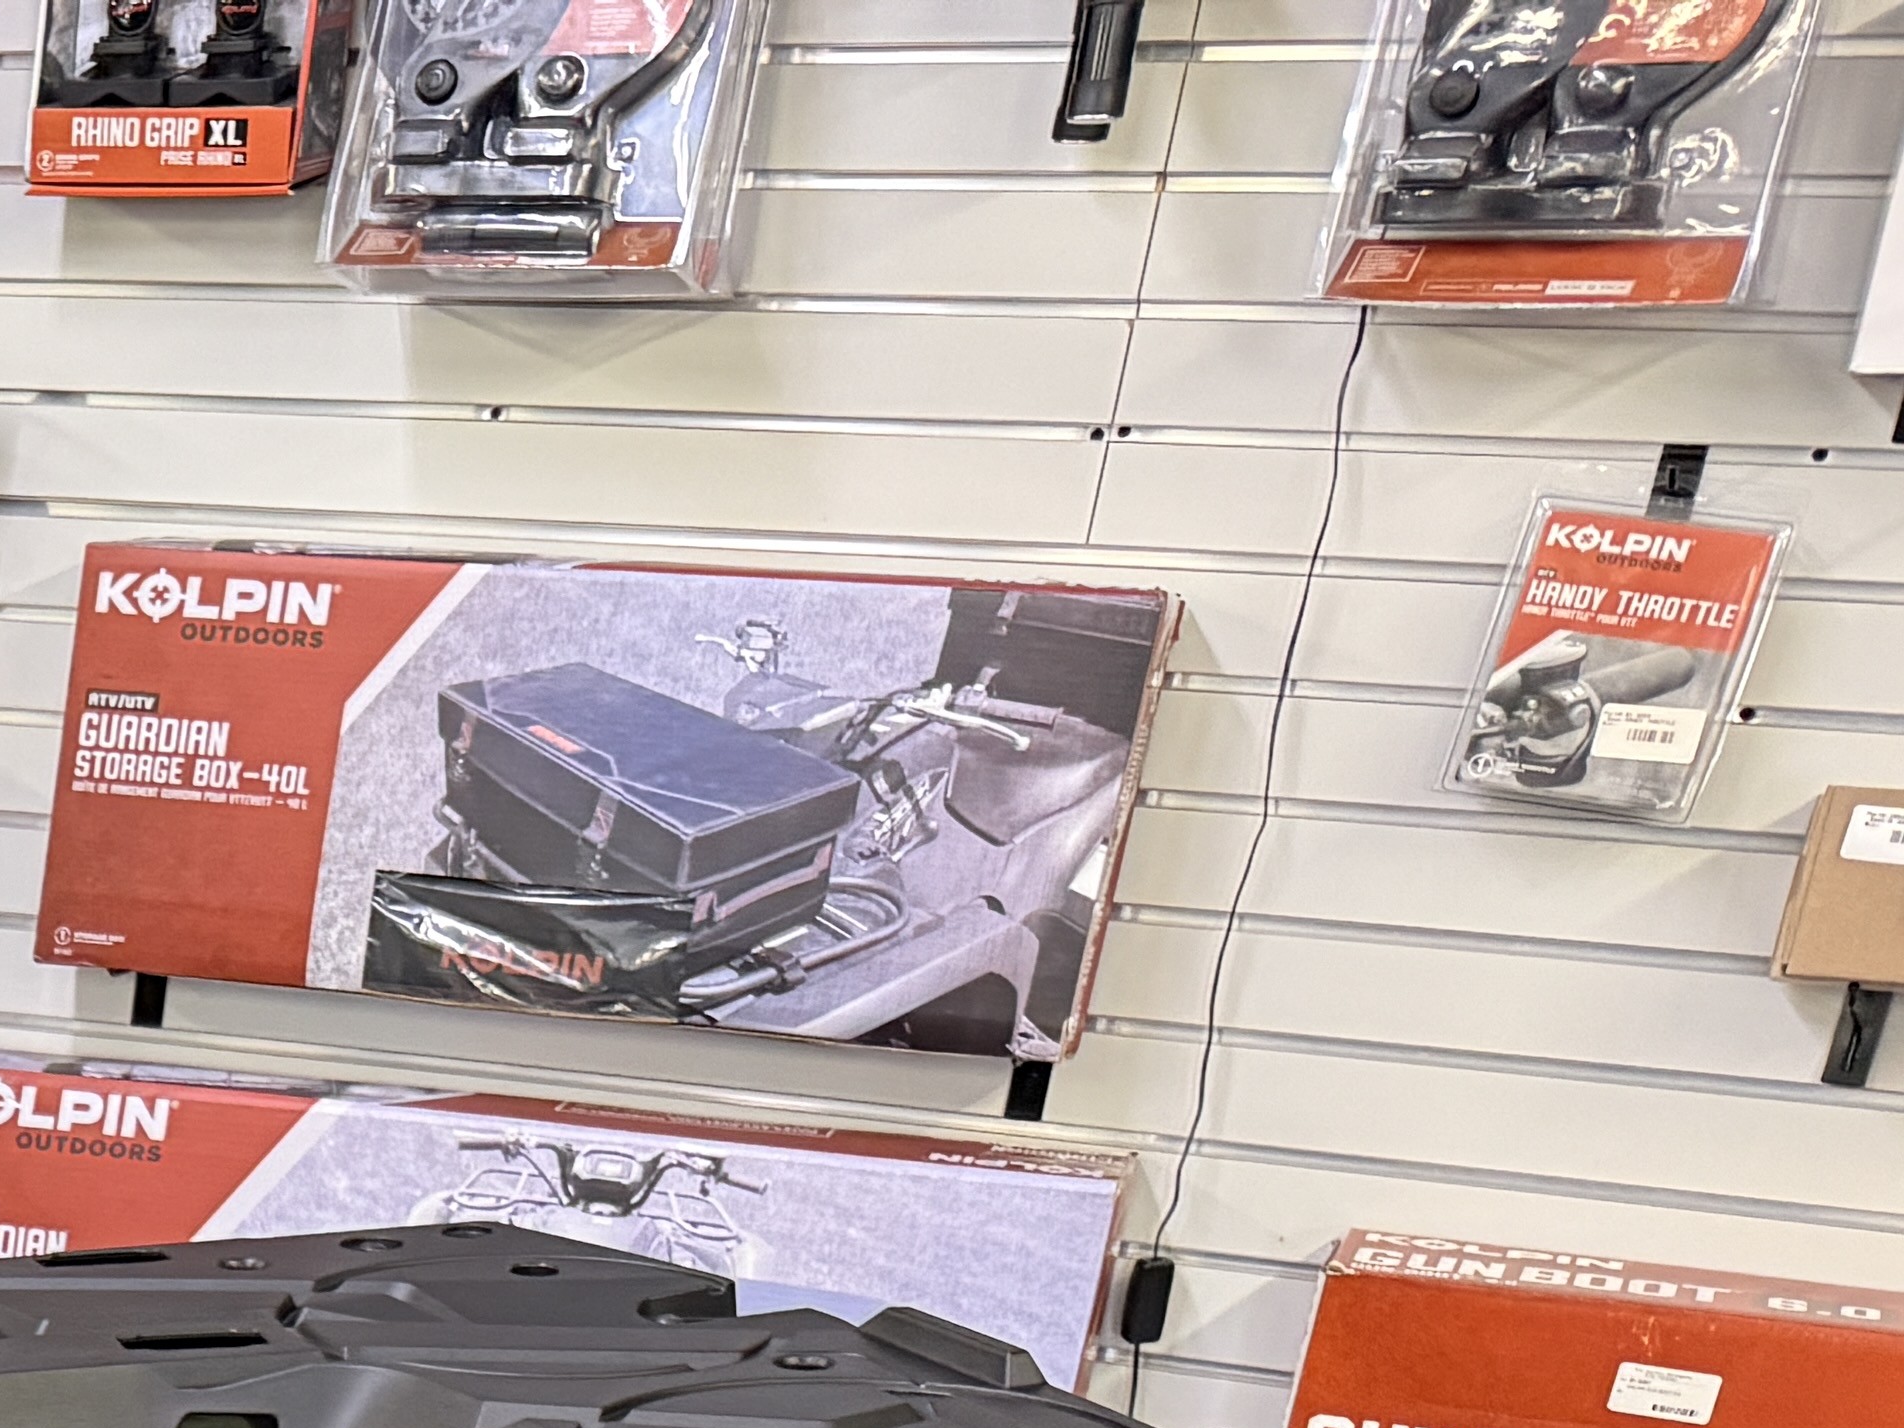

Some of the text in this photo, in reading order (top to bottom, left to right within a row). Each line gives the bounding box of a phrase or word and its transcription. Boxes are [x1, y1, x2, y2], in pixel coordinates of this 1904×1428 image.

[70, 116, 244, 149] RHINO GRIP XL
[1545, 523, 1693, 564] KOLPIN
[95, 568, 333, 627] KOLPIN
[1525, 578, 1740, 630] HANDY THROTTLE
[180, 622, 325, 649] OUTDOORS
[87, 692, 157, 710] ATV/UTV
[78, 712, 231, 757] GUARDIAN
[73, 749, 311, 796] STORAGE BOX-40L
[15, 1131, 163, 1163] OUTDOORS
[1364, 1231, 1625, 1273] KOLPIN
[1351, 1246, 1883, 1323] GUN BOOT 6.0
